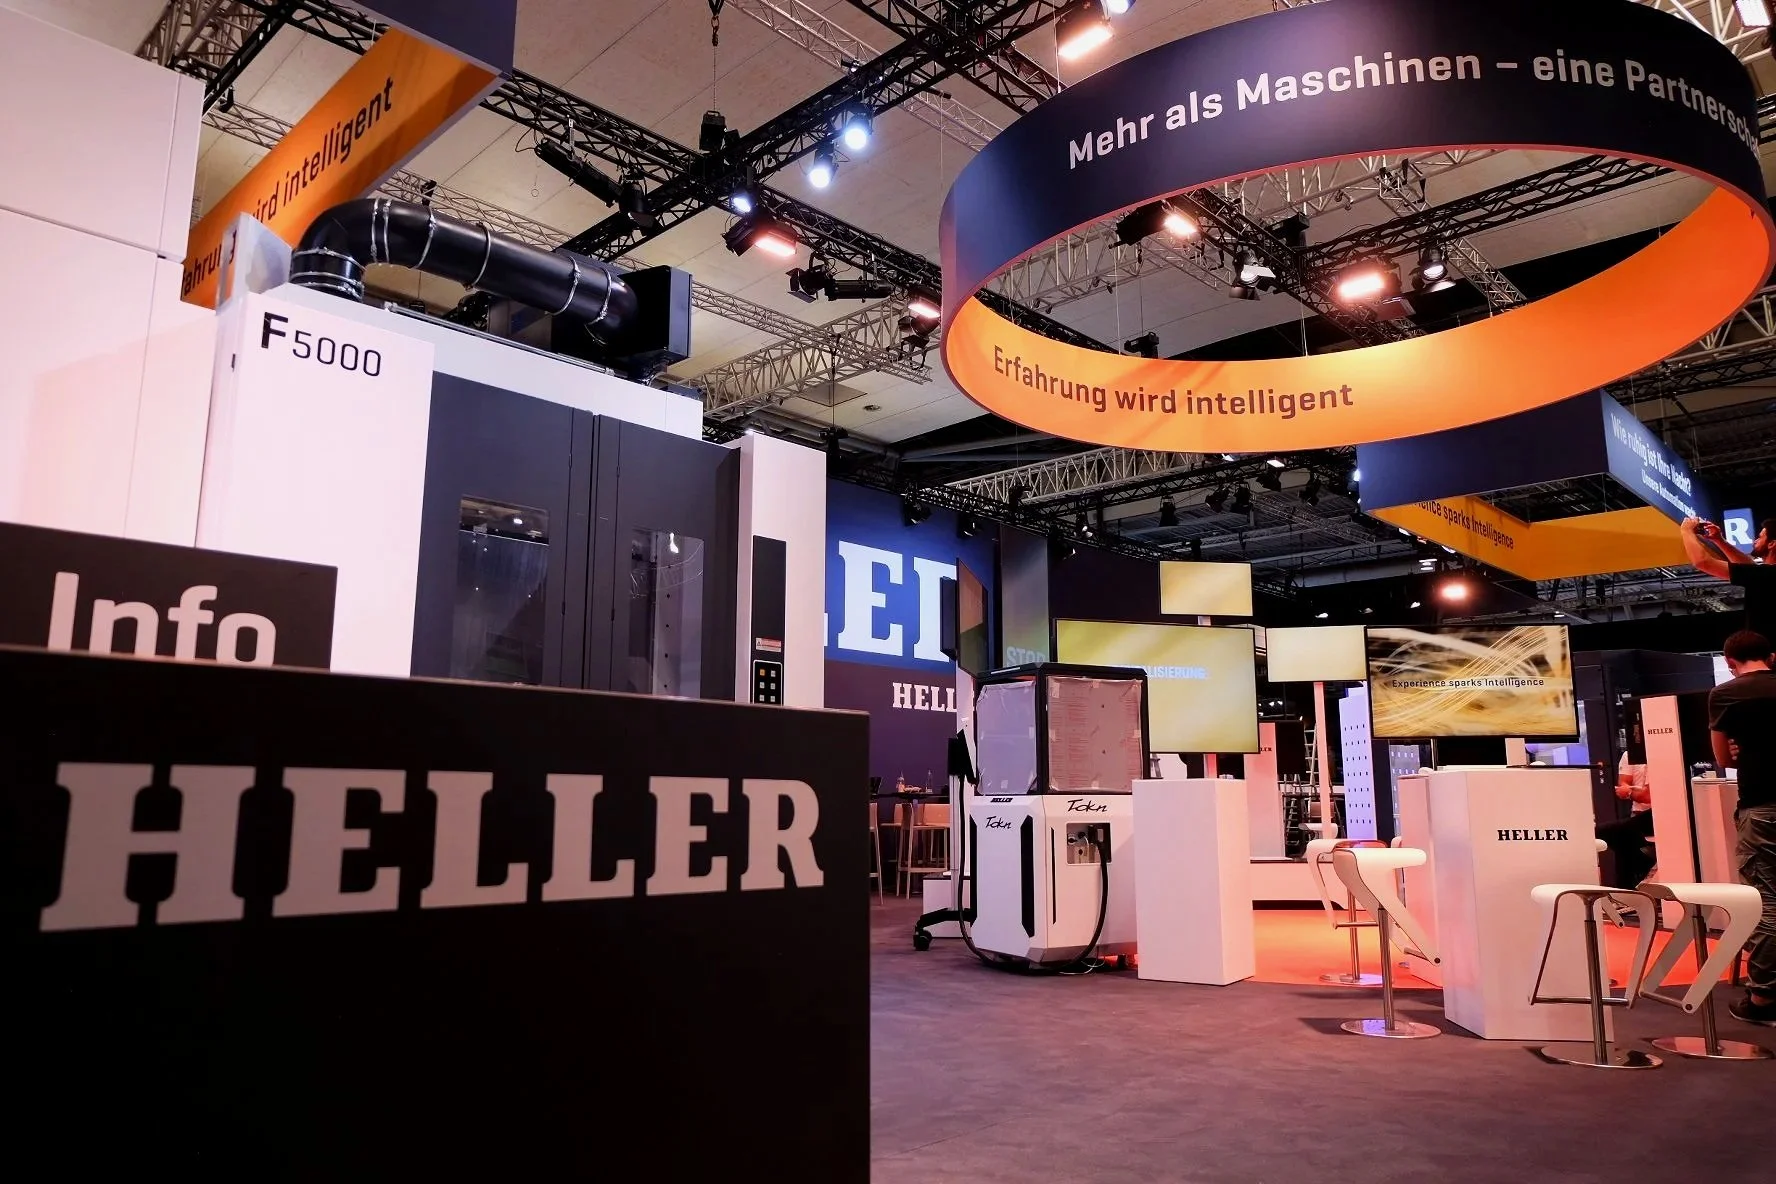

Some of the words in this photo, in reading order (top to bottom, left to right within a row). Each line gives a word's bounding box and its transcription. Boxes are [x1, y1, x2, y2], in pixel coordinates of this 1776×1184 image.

[1069, 112, 1154, 170] Mehr
[1165, 91, 1223, 130] als
[1236, 51, 1481, 111] Maschinen
[1534, 48, 1615, 88] eine
[283, 77, 394, 207] intelligent
[994, 345, 1108, 413] Erfahrung
[1114, 387, 1177, 415] wird
[1187, 384, 1354, 420] intelligent
[1611, 412, 1627, 445] Wie
[1443, 506, 1471, 530] sparks
[1472, 515, 1514, 549] Intelligence
[47, 571, 277, 666] Info
[892, 682, 958, 713] HELL
[1392, 679, 1446, 689] Experience
[1449, 678, 1482, 689] sparks
[1485, 677, 1545, 688] Intelligence
[1647, 727, 1674, 735] HELLER
[39, 762, 825, 932] HELLER
[1497, 829, 1568, 841] HELLER
